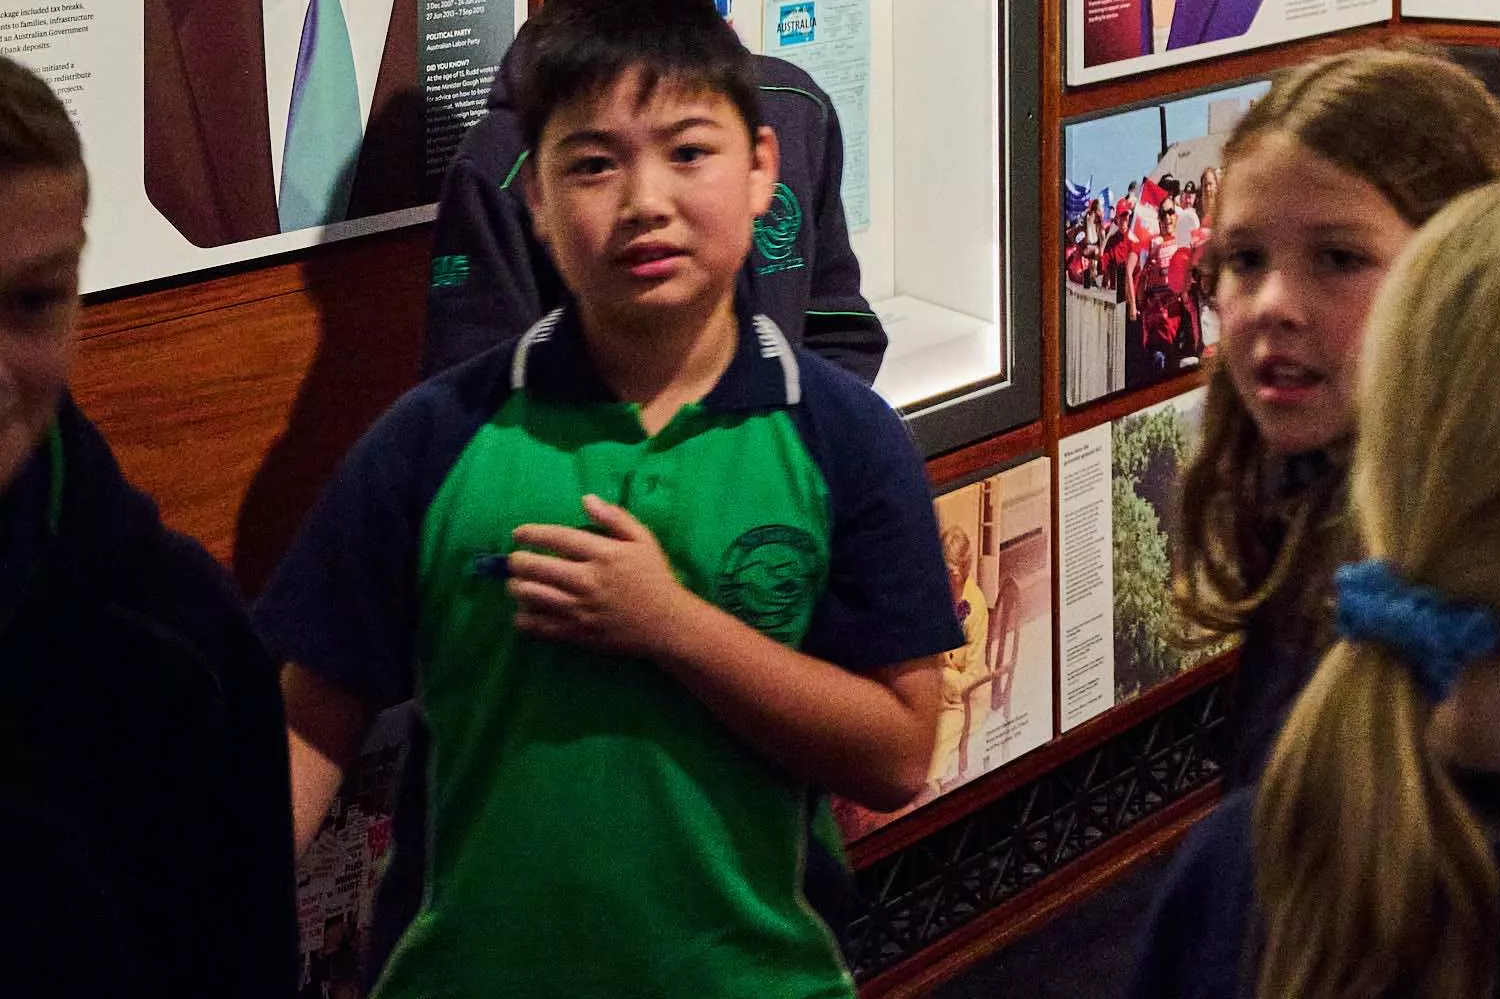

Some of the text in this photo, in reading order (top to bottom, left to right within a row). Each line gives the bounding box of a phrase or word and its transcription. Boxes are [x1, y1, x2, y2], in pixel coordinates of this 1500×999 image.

[776, 16, 817, 33] AUSTRALIA
[13, 30, 48, 41] Australian
[48, 26, 89, 36] Government
